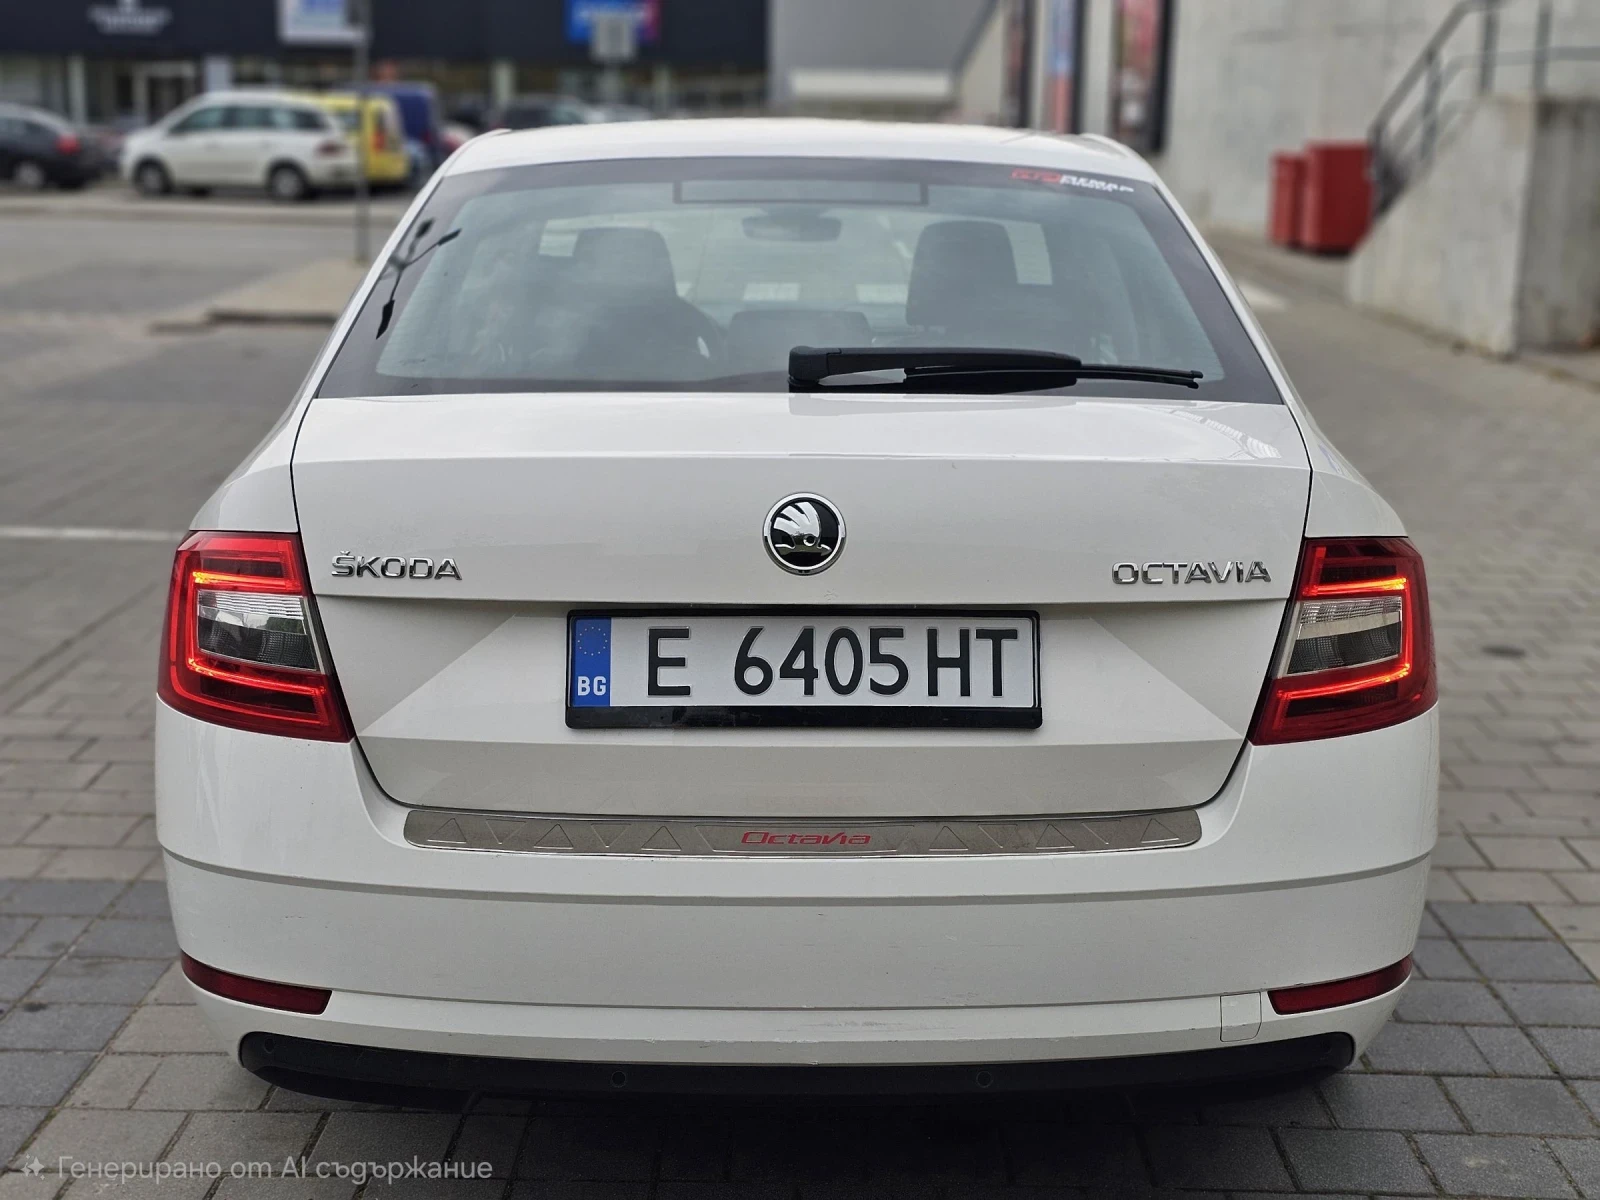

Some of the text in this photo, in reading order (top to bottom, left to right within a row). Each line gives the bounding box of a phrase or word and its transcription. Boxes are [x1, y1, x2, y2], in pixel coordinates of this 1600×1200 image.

[331, 550, 462, 580] ŠKODA
[1111, 561, 1271, 585] OCTAVIA
[577, 675, 607, 697] BG
[741, 830, 871, 845] Octavia
